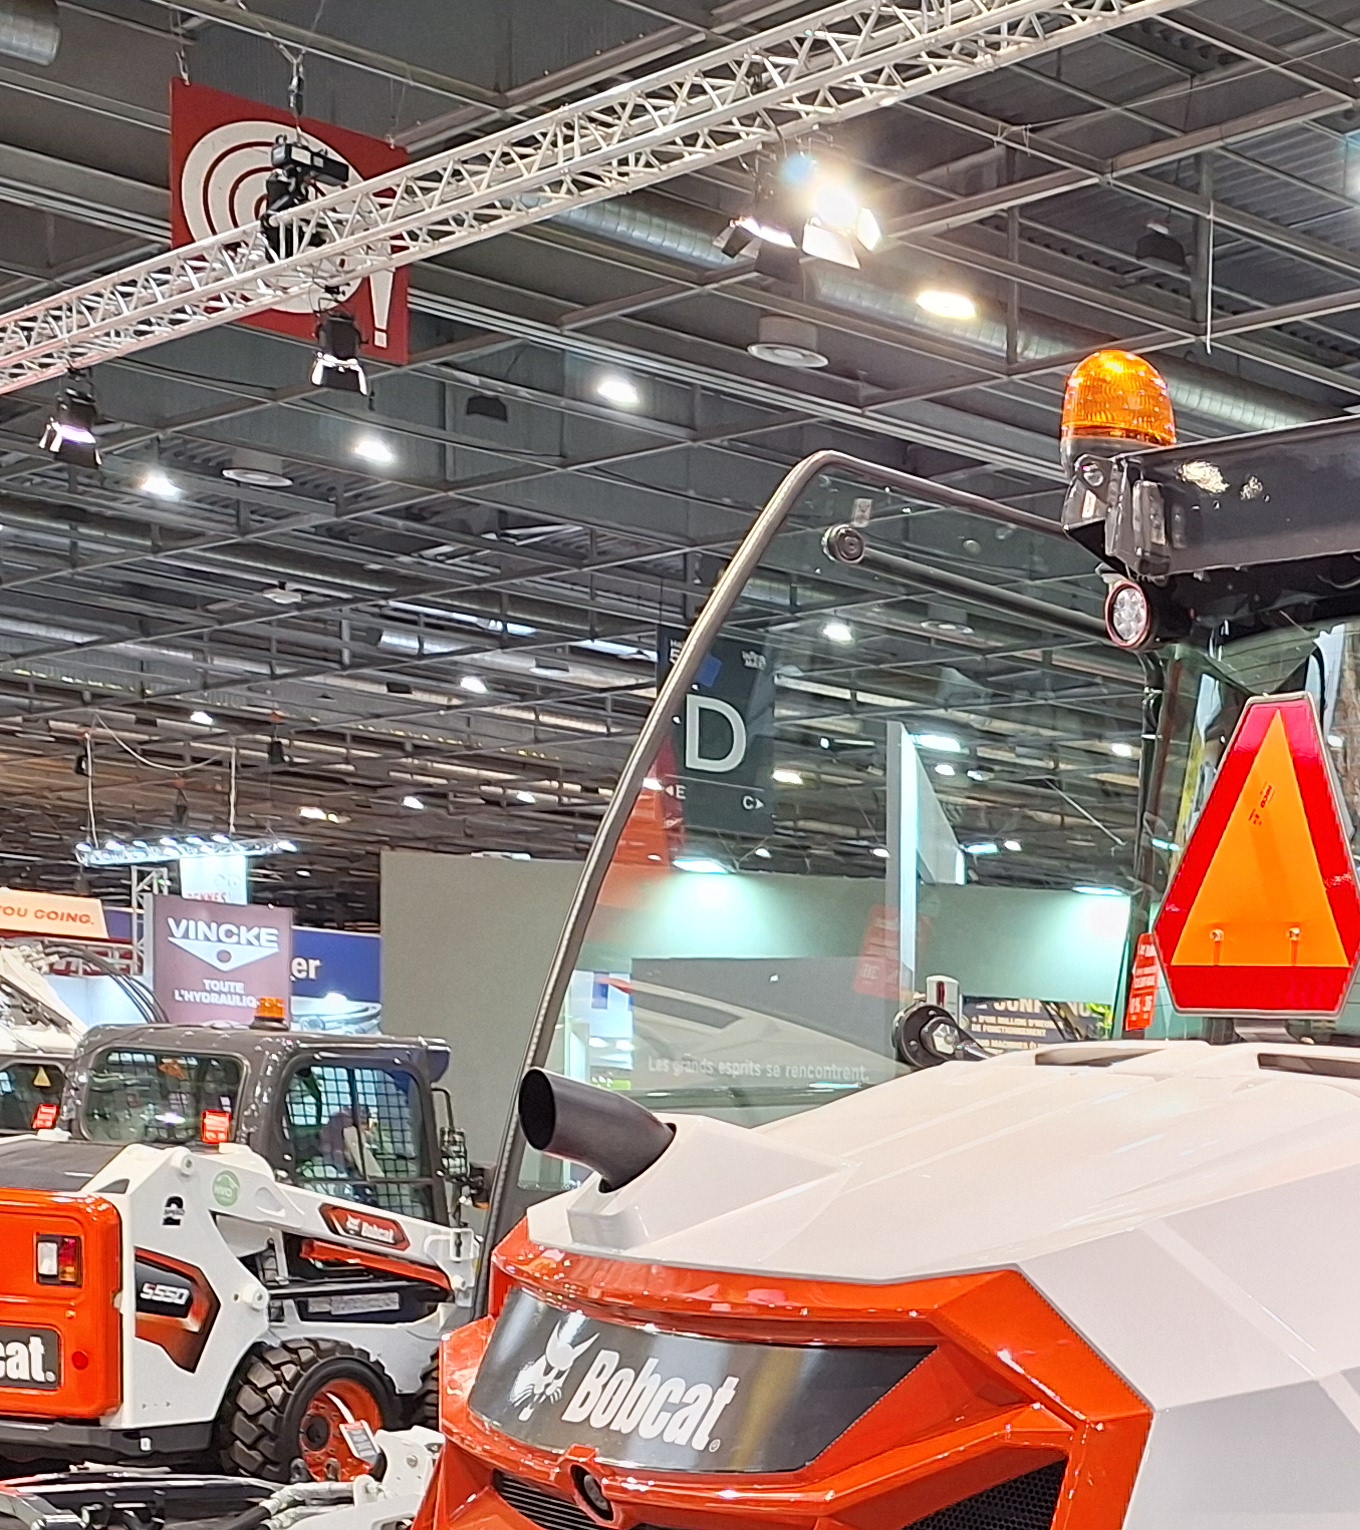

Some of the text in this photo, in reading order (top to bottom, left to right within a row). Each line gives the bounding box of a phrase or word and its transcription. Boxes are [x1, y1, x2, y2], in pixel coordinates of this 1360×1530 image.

[685, 694, 747, 773] D
[676, 784, 687, 800] E
[742, 795, 755, 810] C
[33, 909, 96, 926] GOING.
[166, 917, 280, 948] VINCKE
[290, 954, 322, 982] er
[202, 978, 245, 994] TOUTE
[673, 1056, 714, 1077] grands
[718, 1059, 762, 1079] esprits
[766, 1064, 781, 1078] se
[785, 1064, 870, 1082] rencontrent.
[139, 1282, 191, 1305] S550
